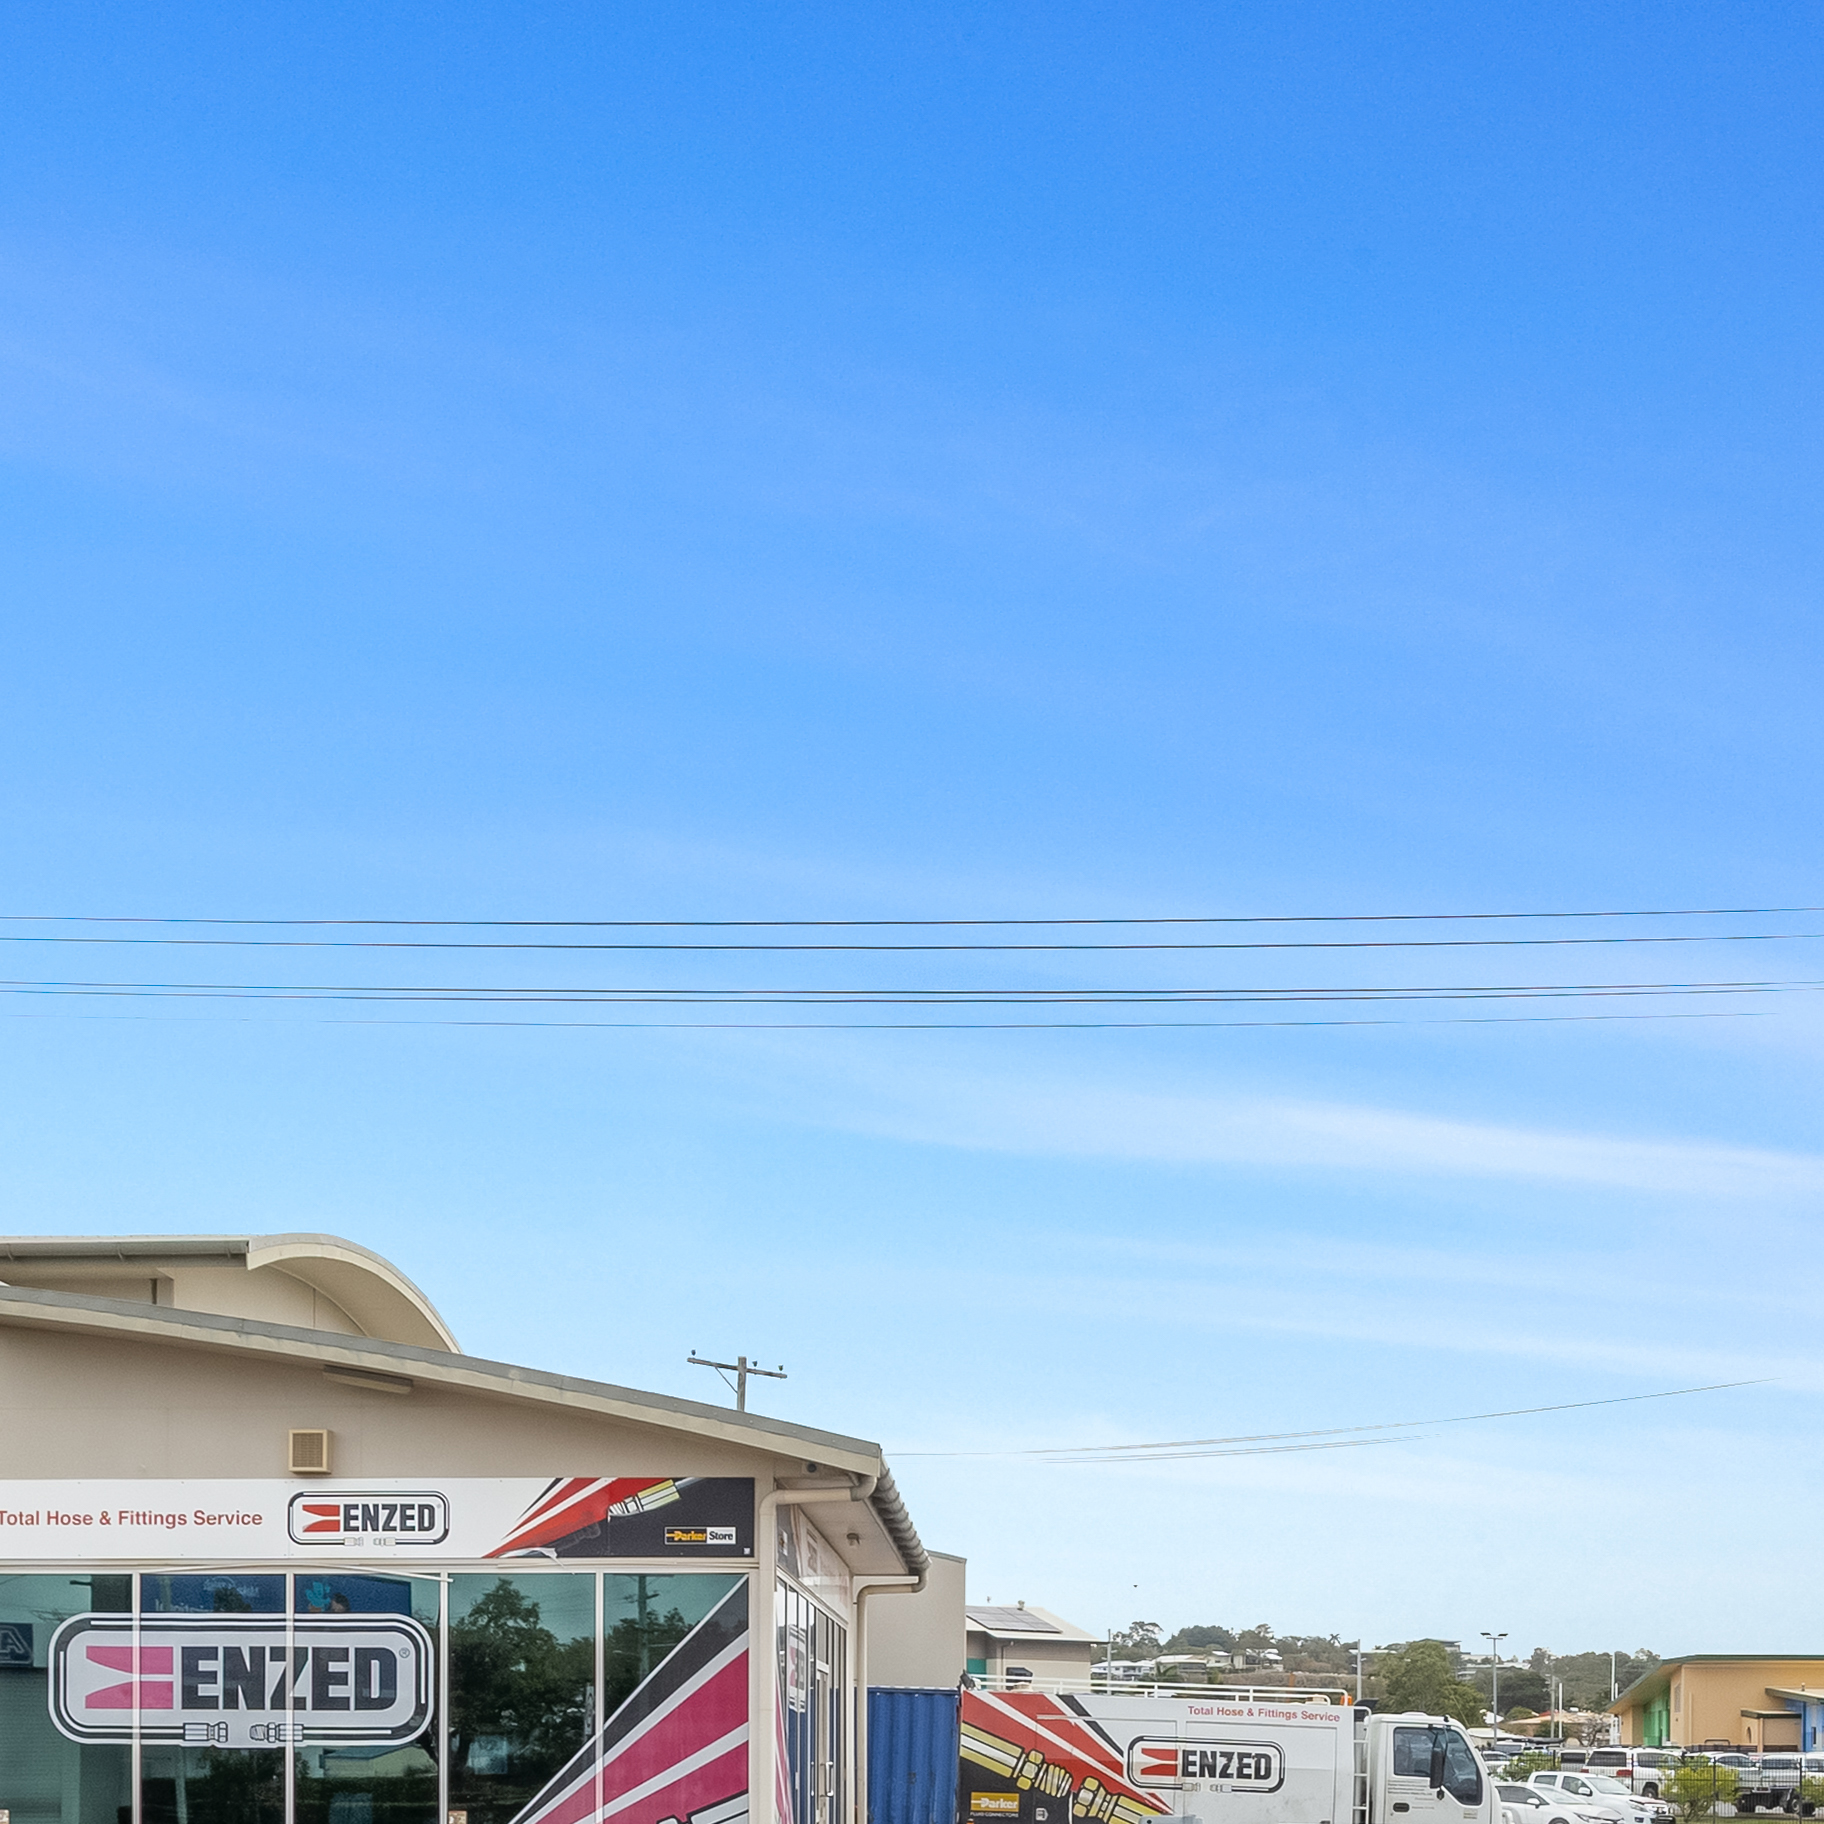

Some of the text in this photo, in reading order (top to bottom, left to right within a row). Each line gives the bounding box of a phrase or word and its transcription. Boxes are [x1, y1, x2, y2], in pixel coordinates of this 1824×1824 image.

[46, 1510, 93, 1526] Hose
[99, 1510, 111, 1526] &
[118, 1510, 188, 1529] Fittings
[193, 1510, 263, 1526] Service
[343, 1503, 436, 1532] ENZED
[673, 1530, 734, 1541] Parker Store
[181, 1645, 397, 1711] ENZED
[1188, 1706, 1341, 1722] Total Hose & Fittings Service
[1181, 1749, 1272, 1781] ENZED
[980, 1797, 1018, 1809] Parker
